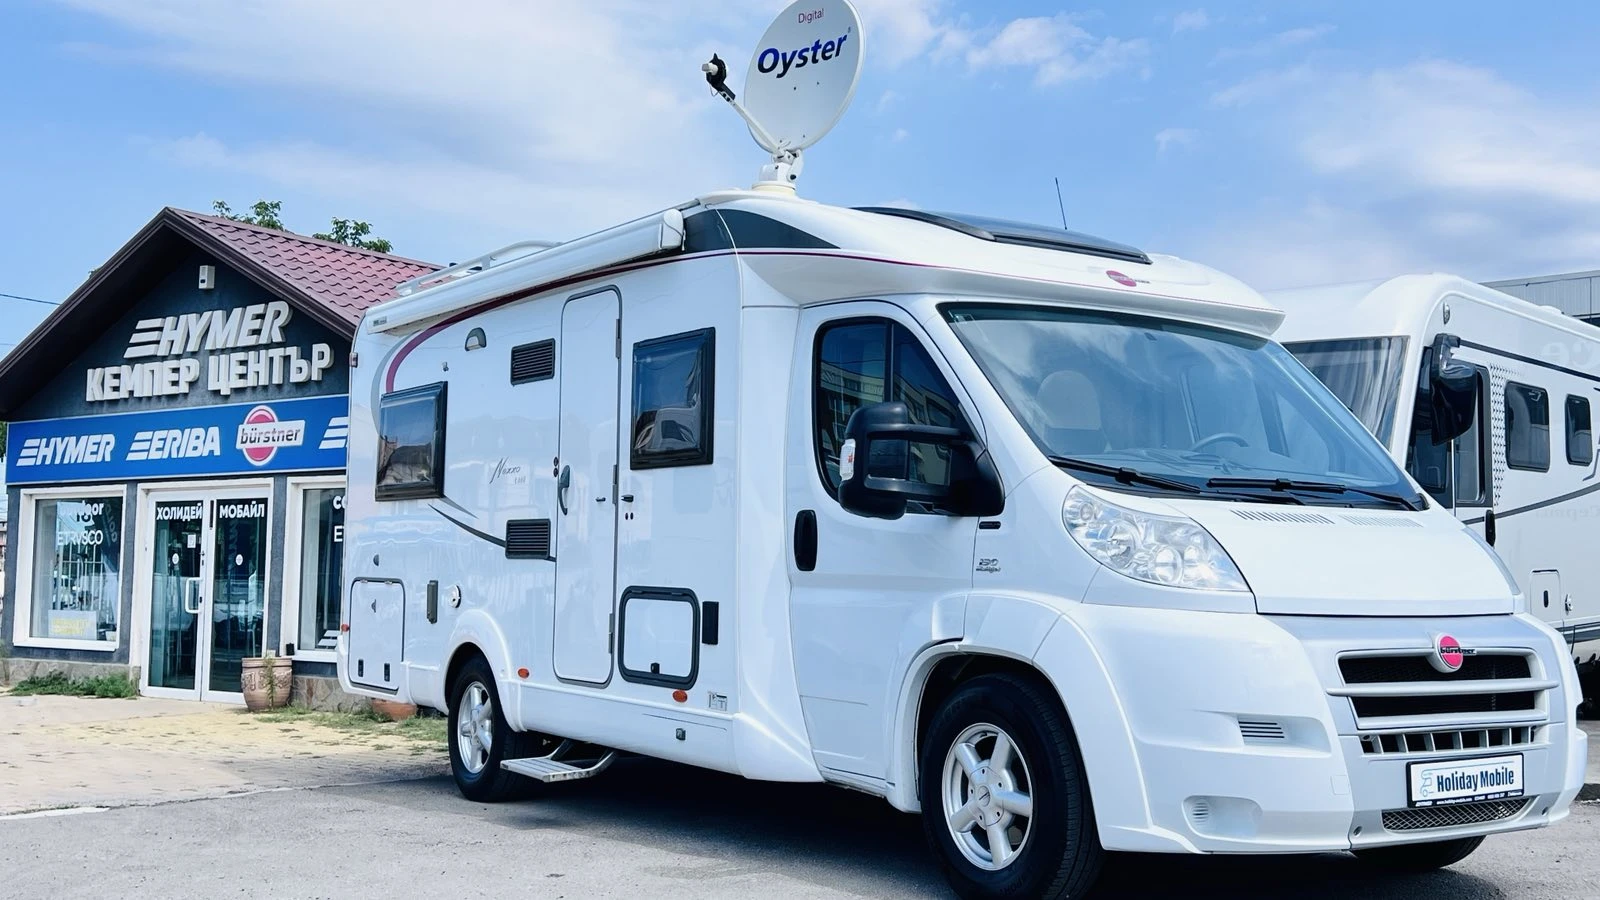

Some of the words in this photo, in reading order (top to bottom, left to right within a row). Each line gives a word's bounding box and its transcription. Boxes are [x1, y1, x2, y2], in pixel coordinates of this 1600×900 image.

[798, 8, 825, 24] Digital
[757, 34, 849, 79] Oyster
[155, 301, 293, 357] HYMER
[86, 358, 200, 402] КЕМПЕР
[208, 342, 334, 395] ЦЕНТЪР
[35, 433, 115, 466] HYMER
[146, 426, 221, 460] ERIBA
[240, 427, 302, 445] bürstner
[156, 503, 202, 521] ХОЛИДЕЙ
[219, 501, 265, 519] МОБАЙЛ
[1436, 770, 1479, 792] Holiday
[1480, 766, 1515, 787] Mobile
